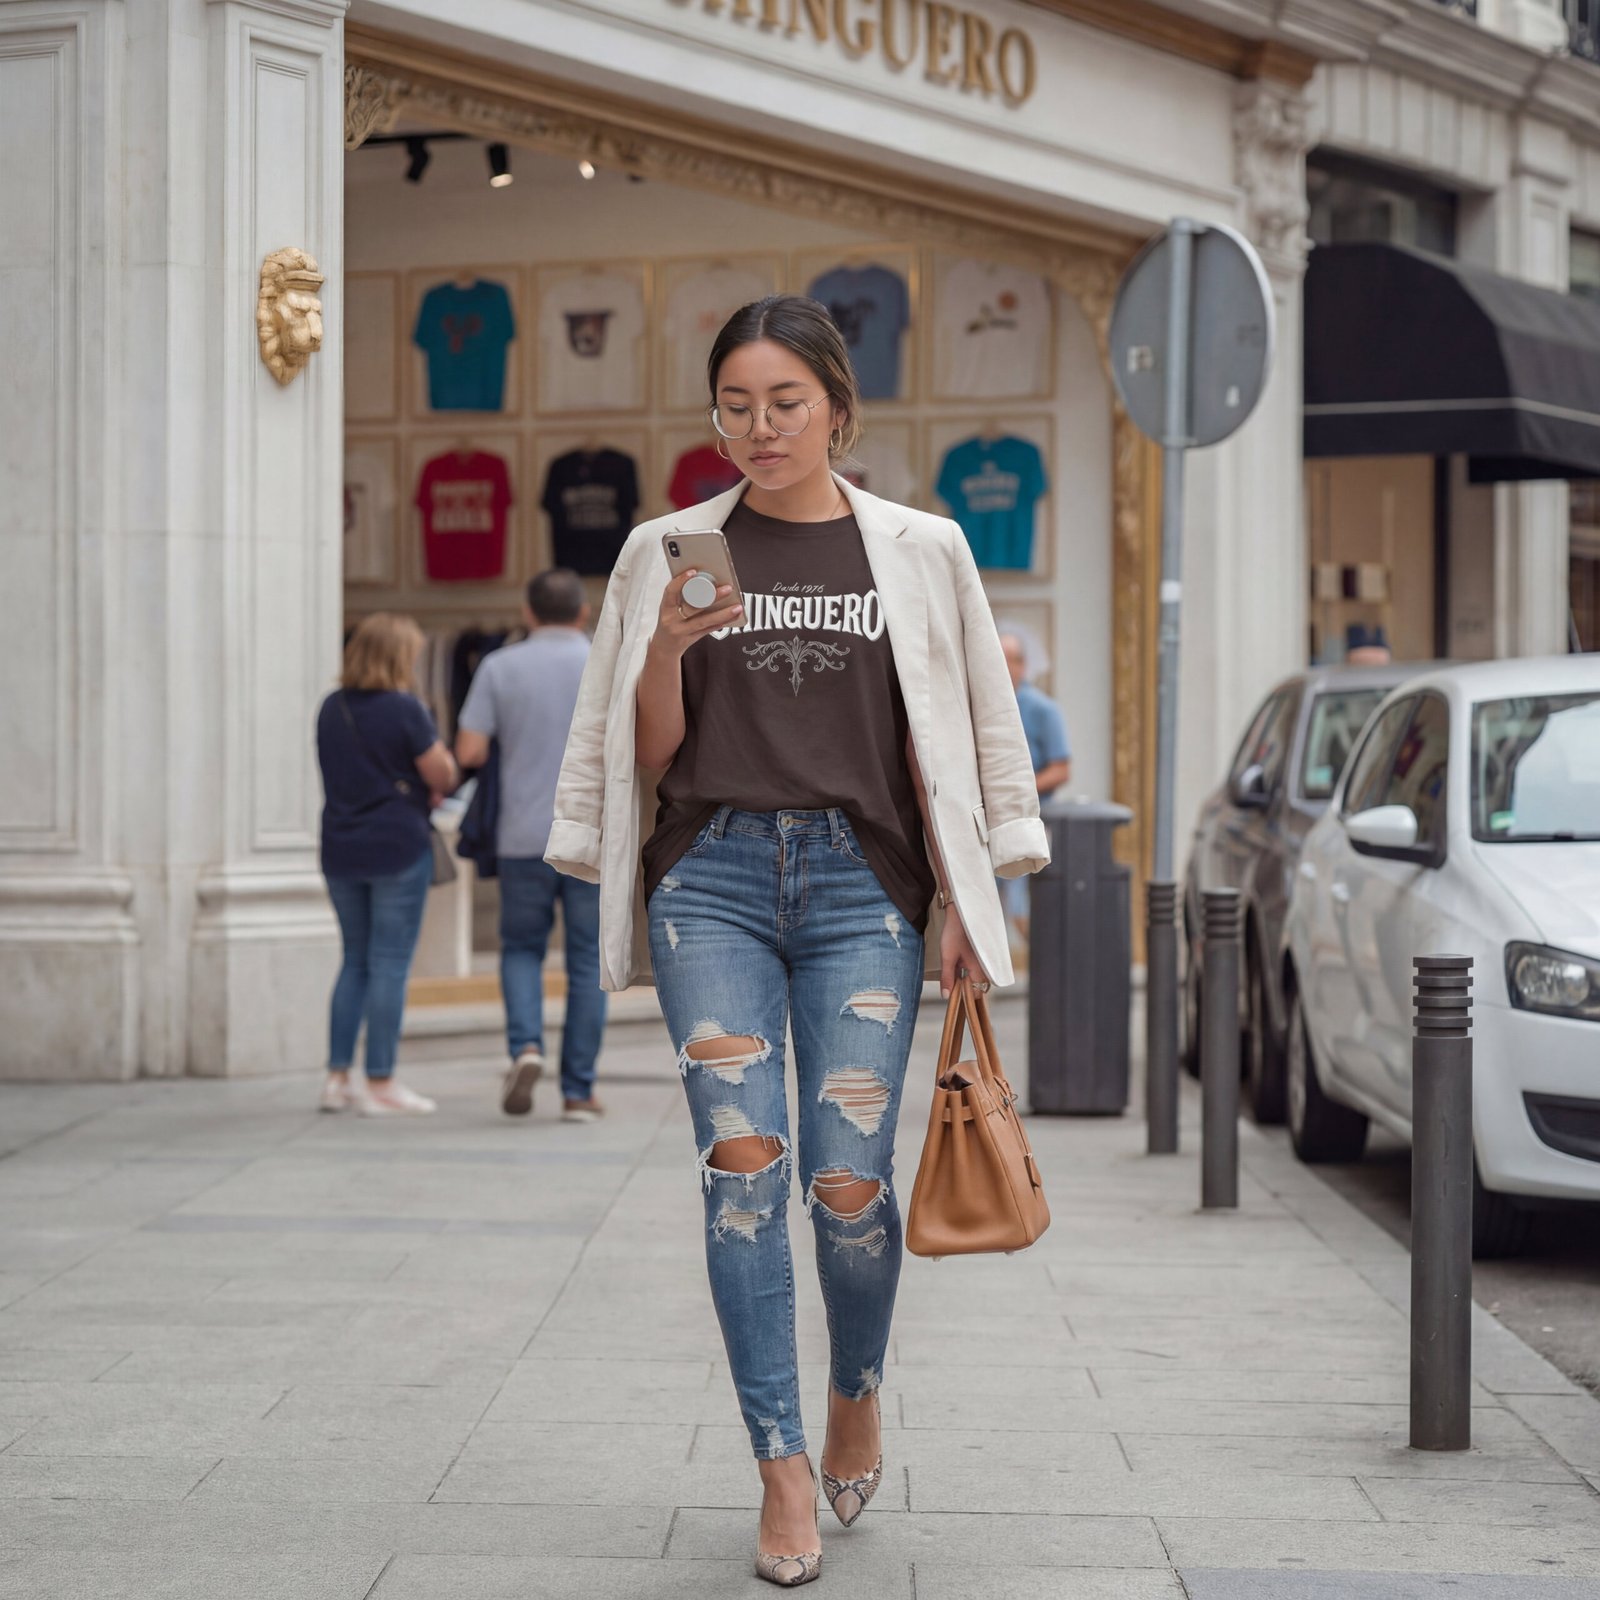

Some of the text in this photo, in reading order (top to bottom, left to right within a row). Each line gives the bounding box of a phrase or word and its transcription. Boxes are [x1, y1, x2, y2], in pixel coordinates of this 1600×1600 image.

[667, 0, 1037, 106] NGUERO
[708, 589, 886, 641] INGUERO
[800, 584, 825, 594] 1976
